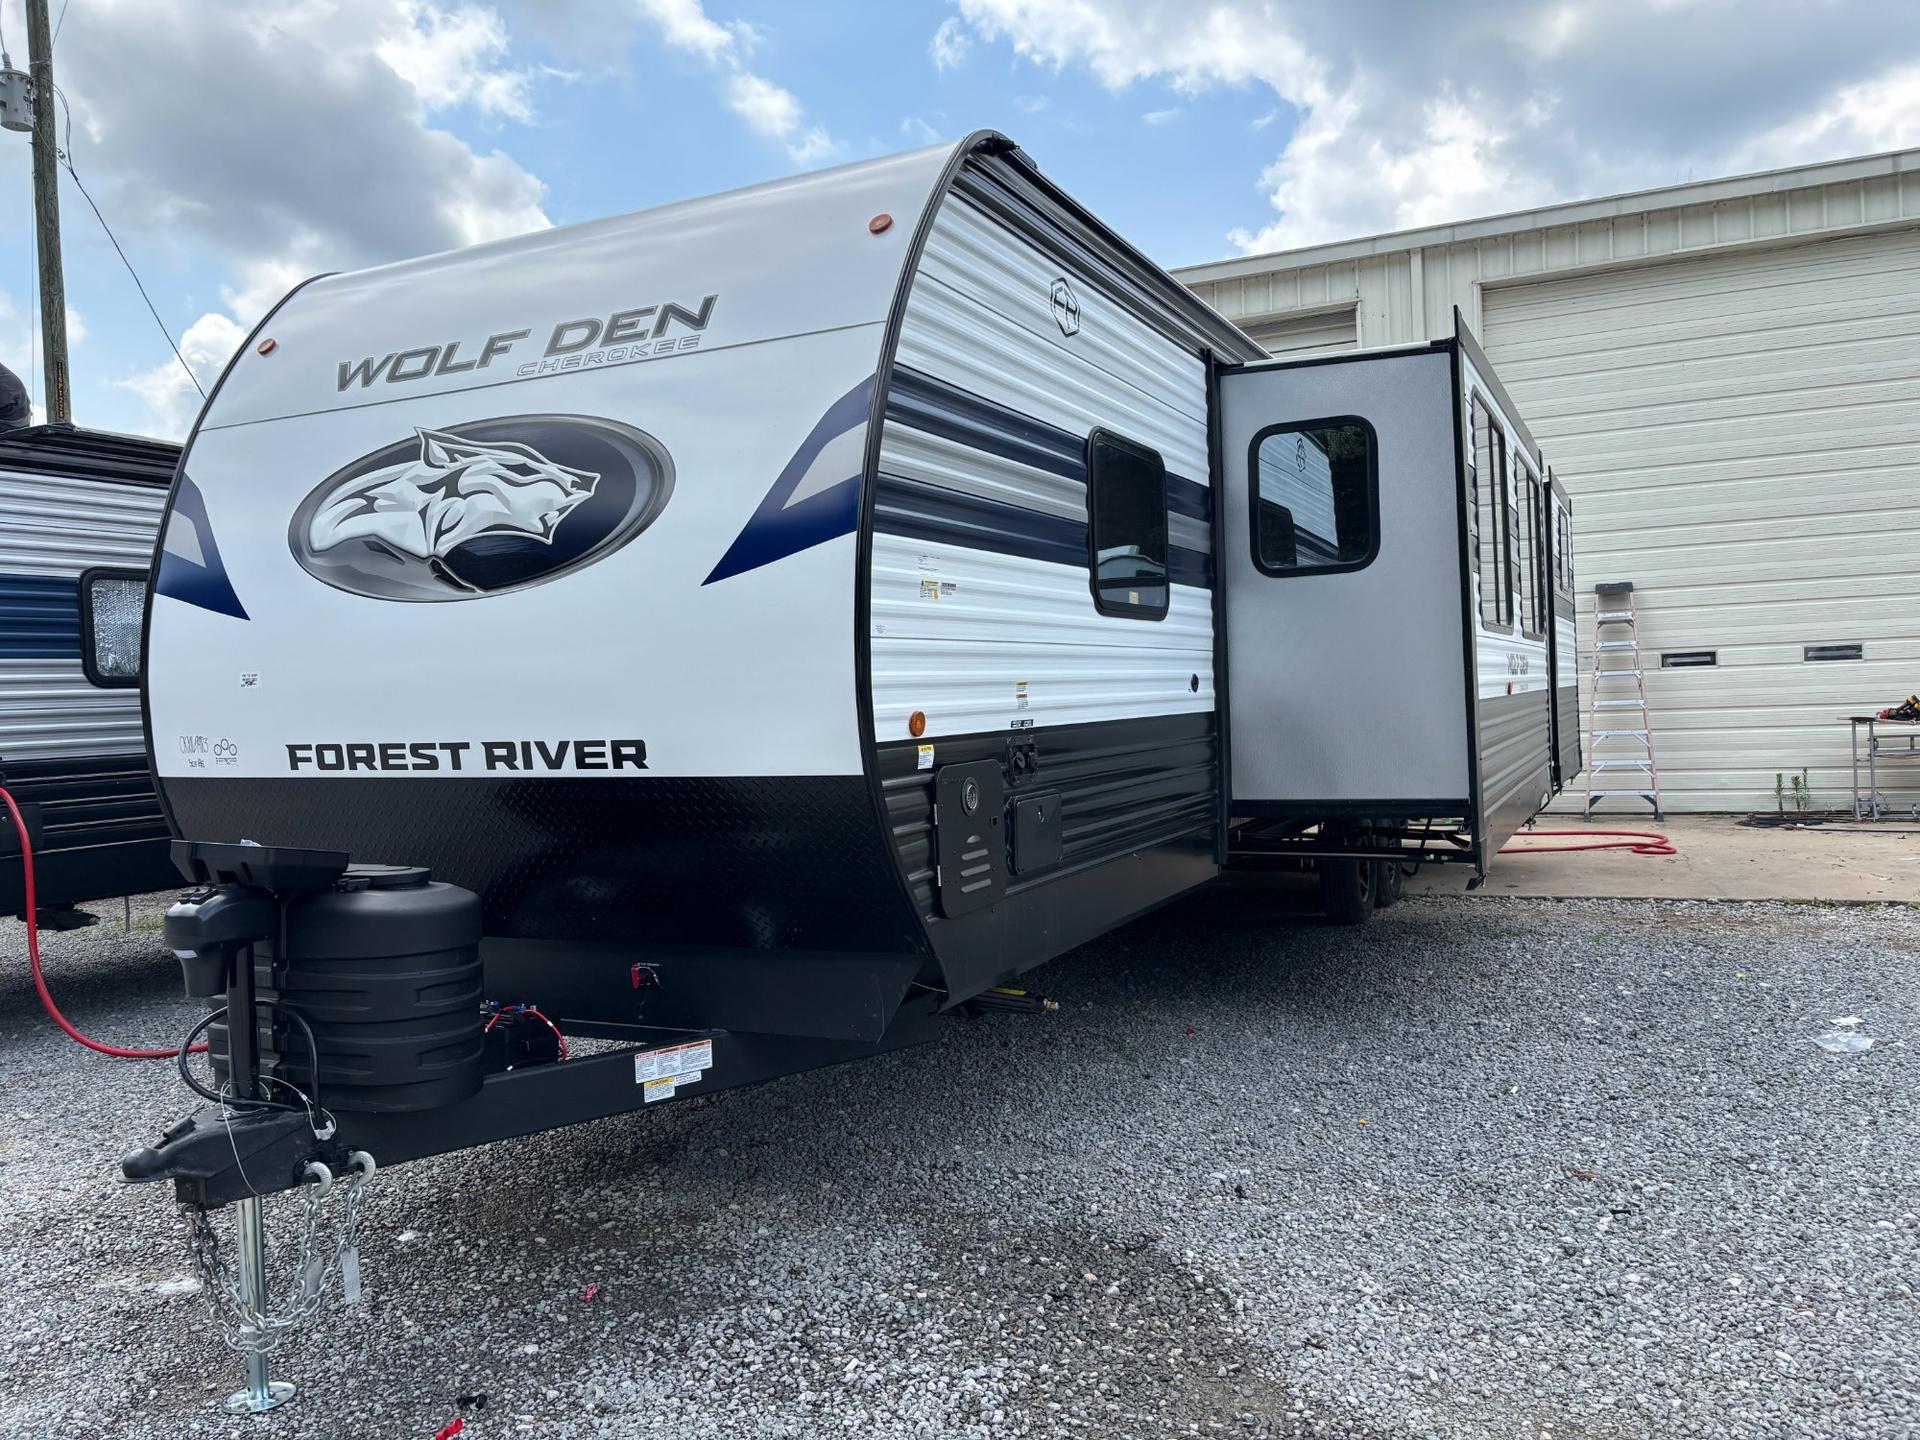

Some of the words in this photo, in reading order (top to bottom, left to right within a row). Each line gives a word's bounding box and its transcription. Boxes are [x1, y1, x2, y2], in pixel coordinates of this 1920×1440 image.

[337, 328, 531, 392] WOLF
[543, 294, 719, 358] DEN
[516, 335, 702, 377] CHEROKEE
[285, 741, 470, 771] FOREST
[480, 739, 650, 771] RIVER
